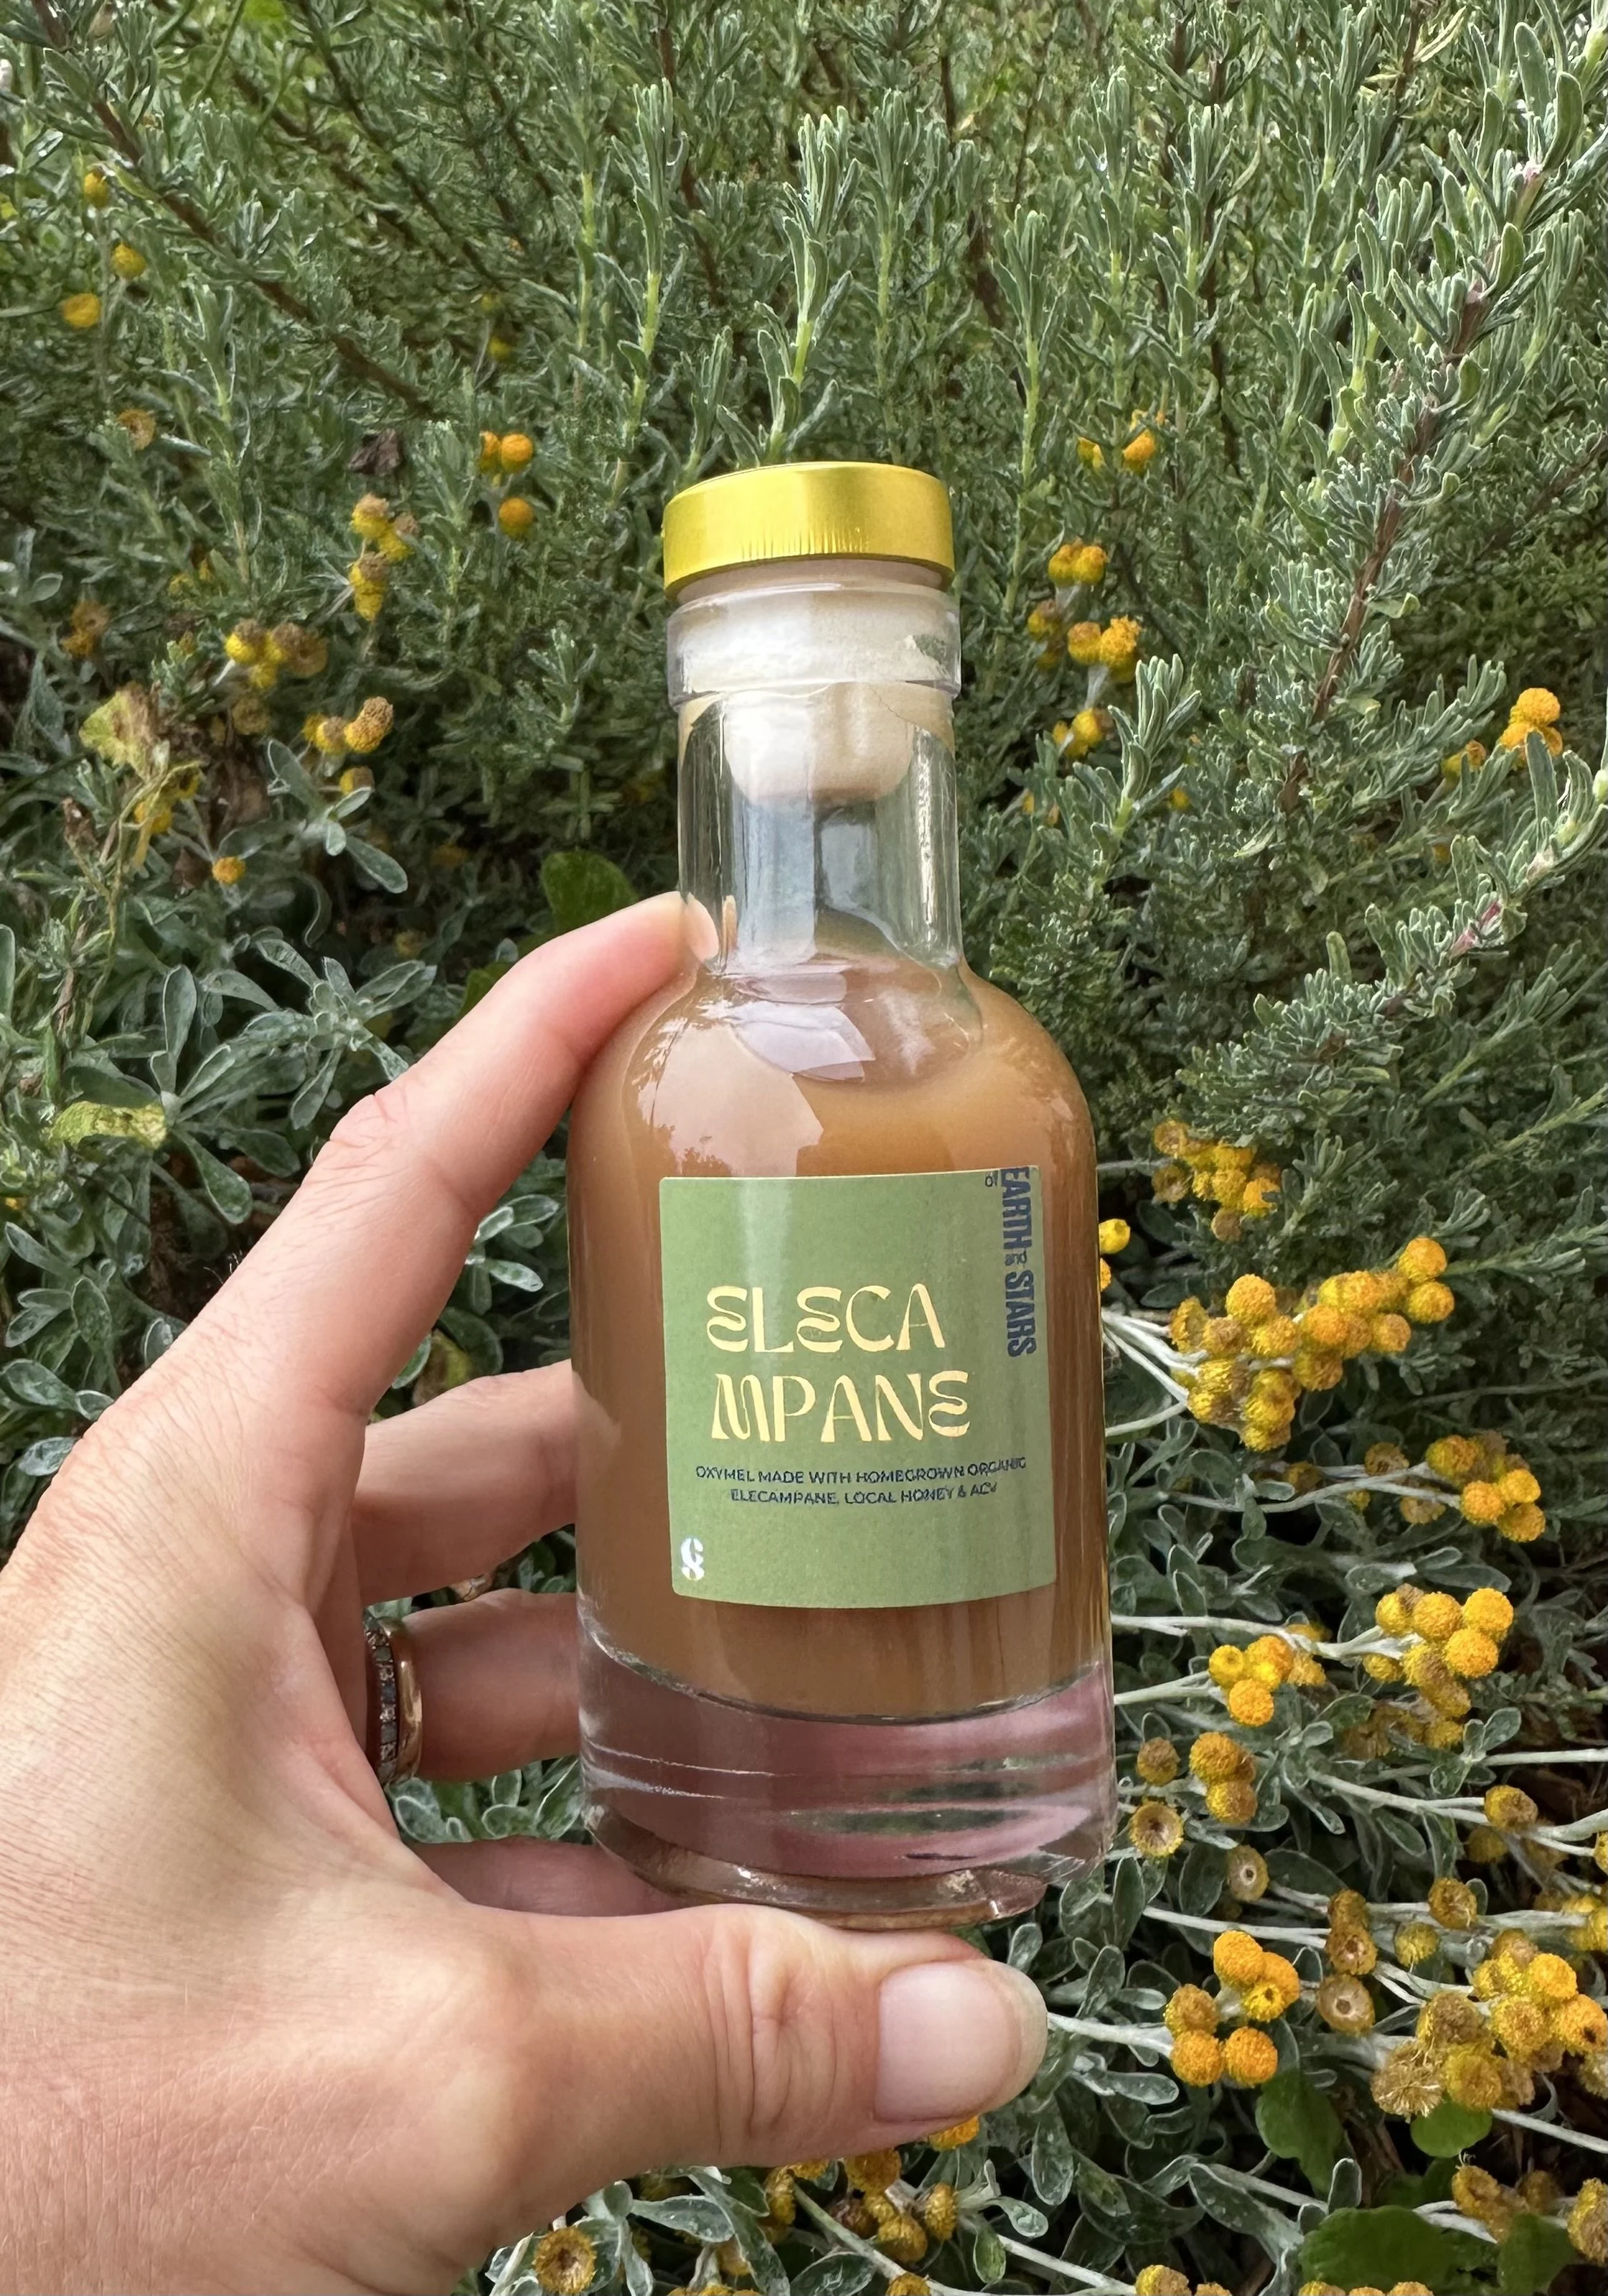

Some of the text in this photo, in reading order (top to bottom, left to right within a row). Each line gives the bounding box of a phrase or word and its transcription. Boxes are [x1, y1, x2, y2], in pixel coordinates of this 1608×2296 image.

[1000, 1166, 1033, 1250] EARTH
[706, 1283, 946, 1353] ELECA
[1005, 1269, 1037, 1357] STARS
[711, 1369, 970, 1443] MPANE
[695, 1466, 756, 1483] OXYMEL
[758, 1470, 805, 1484] MADE
[809, 1471, 852, 1485] WITH
[855, 1466, 965, 1484] HOMEGROWN
[845, 1491, 897, 1505] LOCAL
[901, 1486, 955, 1504] HONEY
